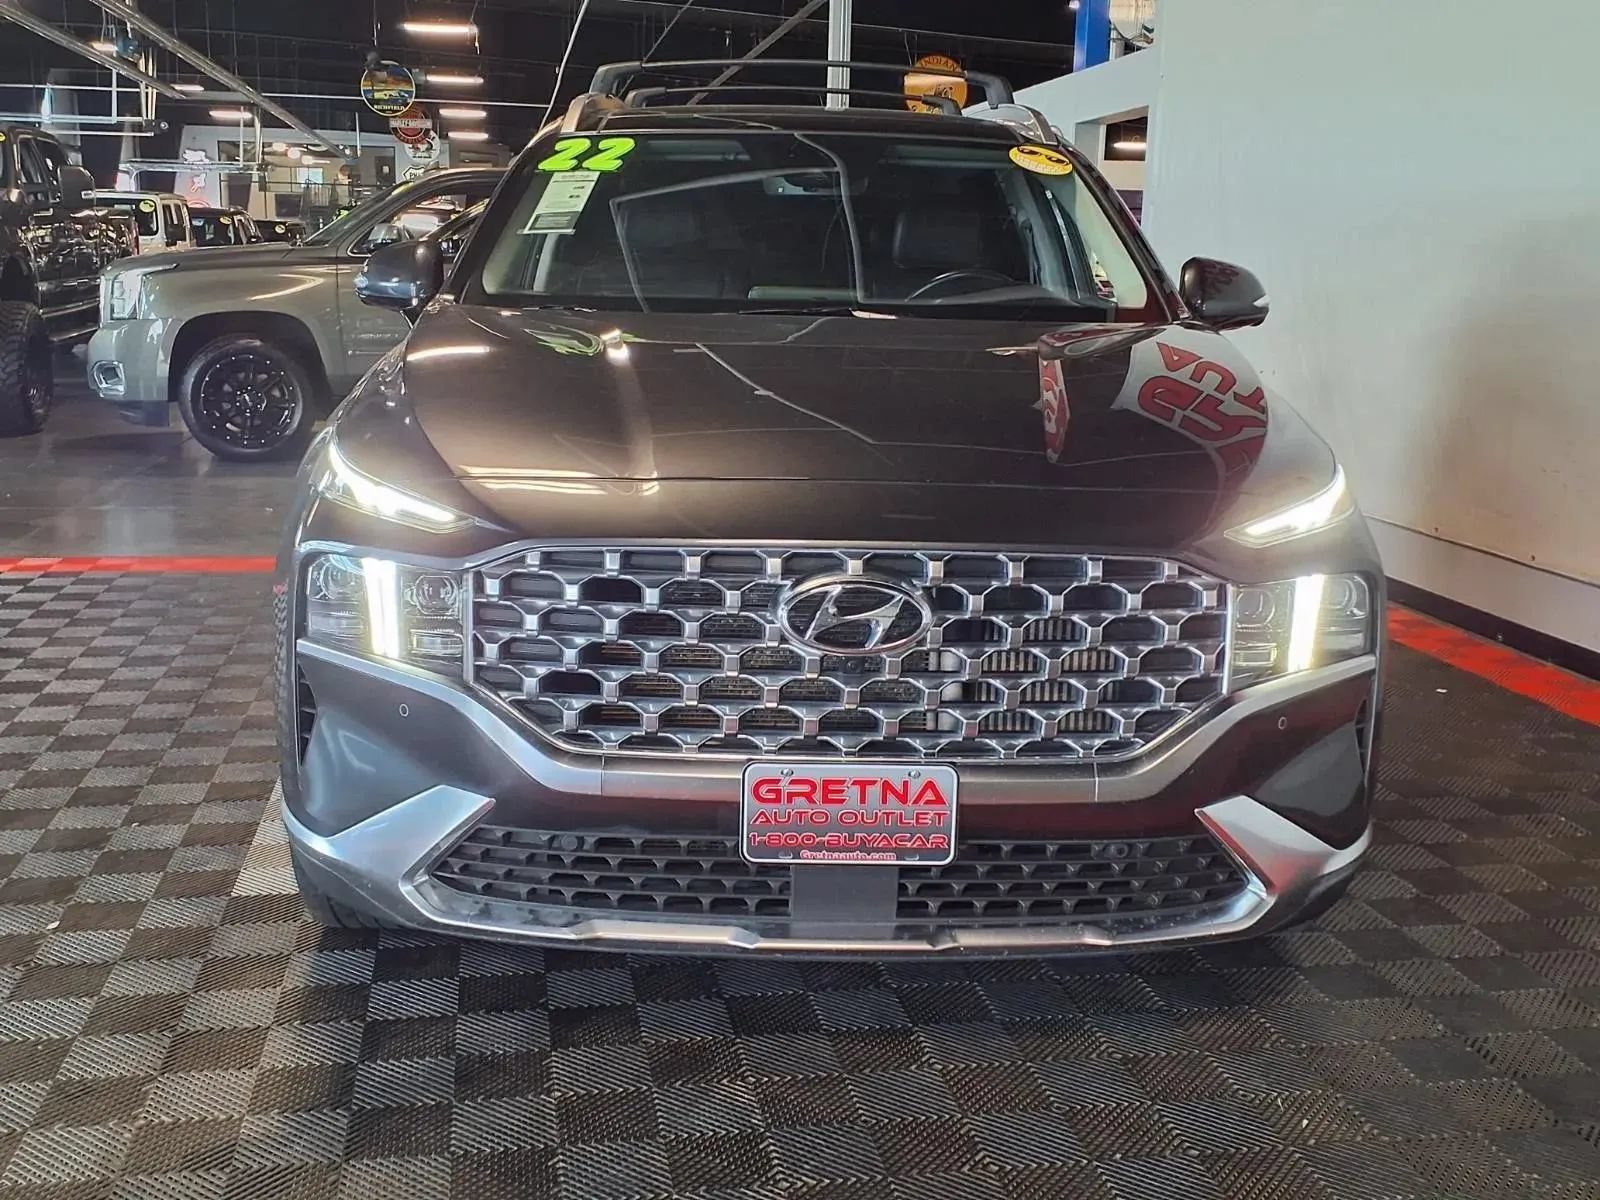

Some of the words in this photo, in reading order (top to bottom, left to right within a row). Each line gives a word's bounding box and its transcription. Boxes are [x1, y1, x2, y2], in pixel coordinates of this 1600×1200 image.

[537, 138, 636, 171] 22
[752, 777, 948, 806] GRETNA
[750, 809, 830, 826] AUTO
[838, 810, 950, 827] OUTLET
[749, 832, 949, 849] 1-800-BUYACAR
